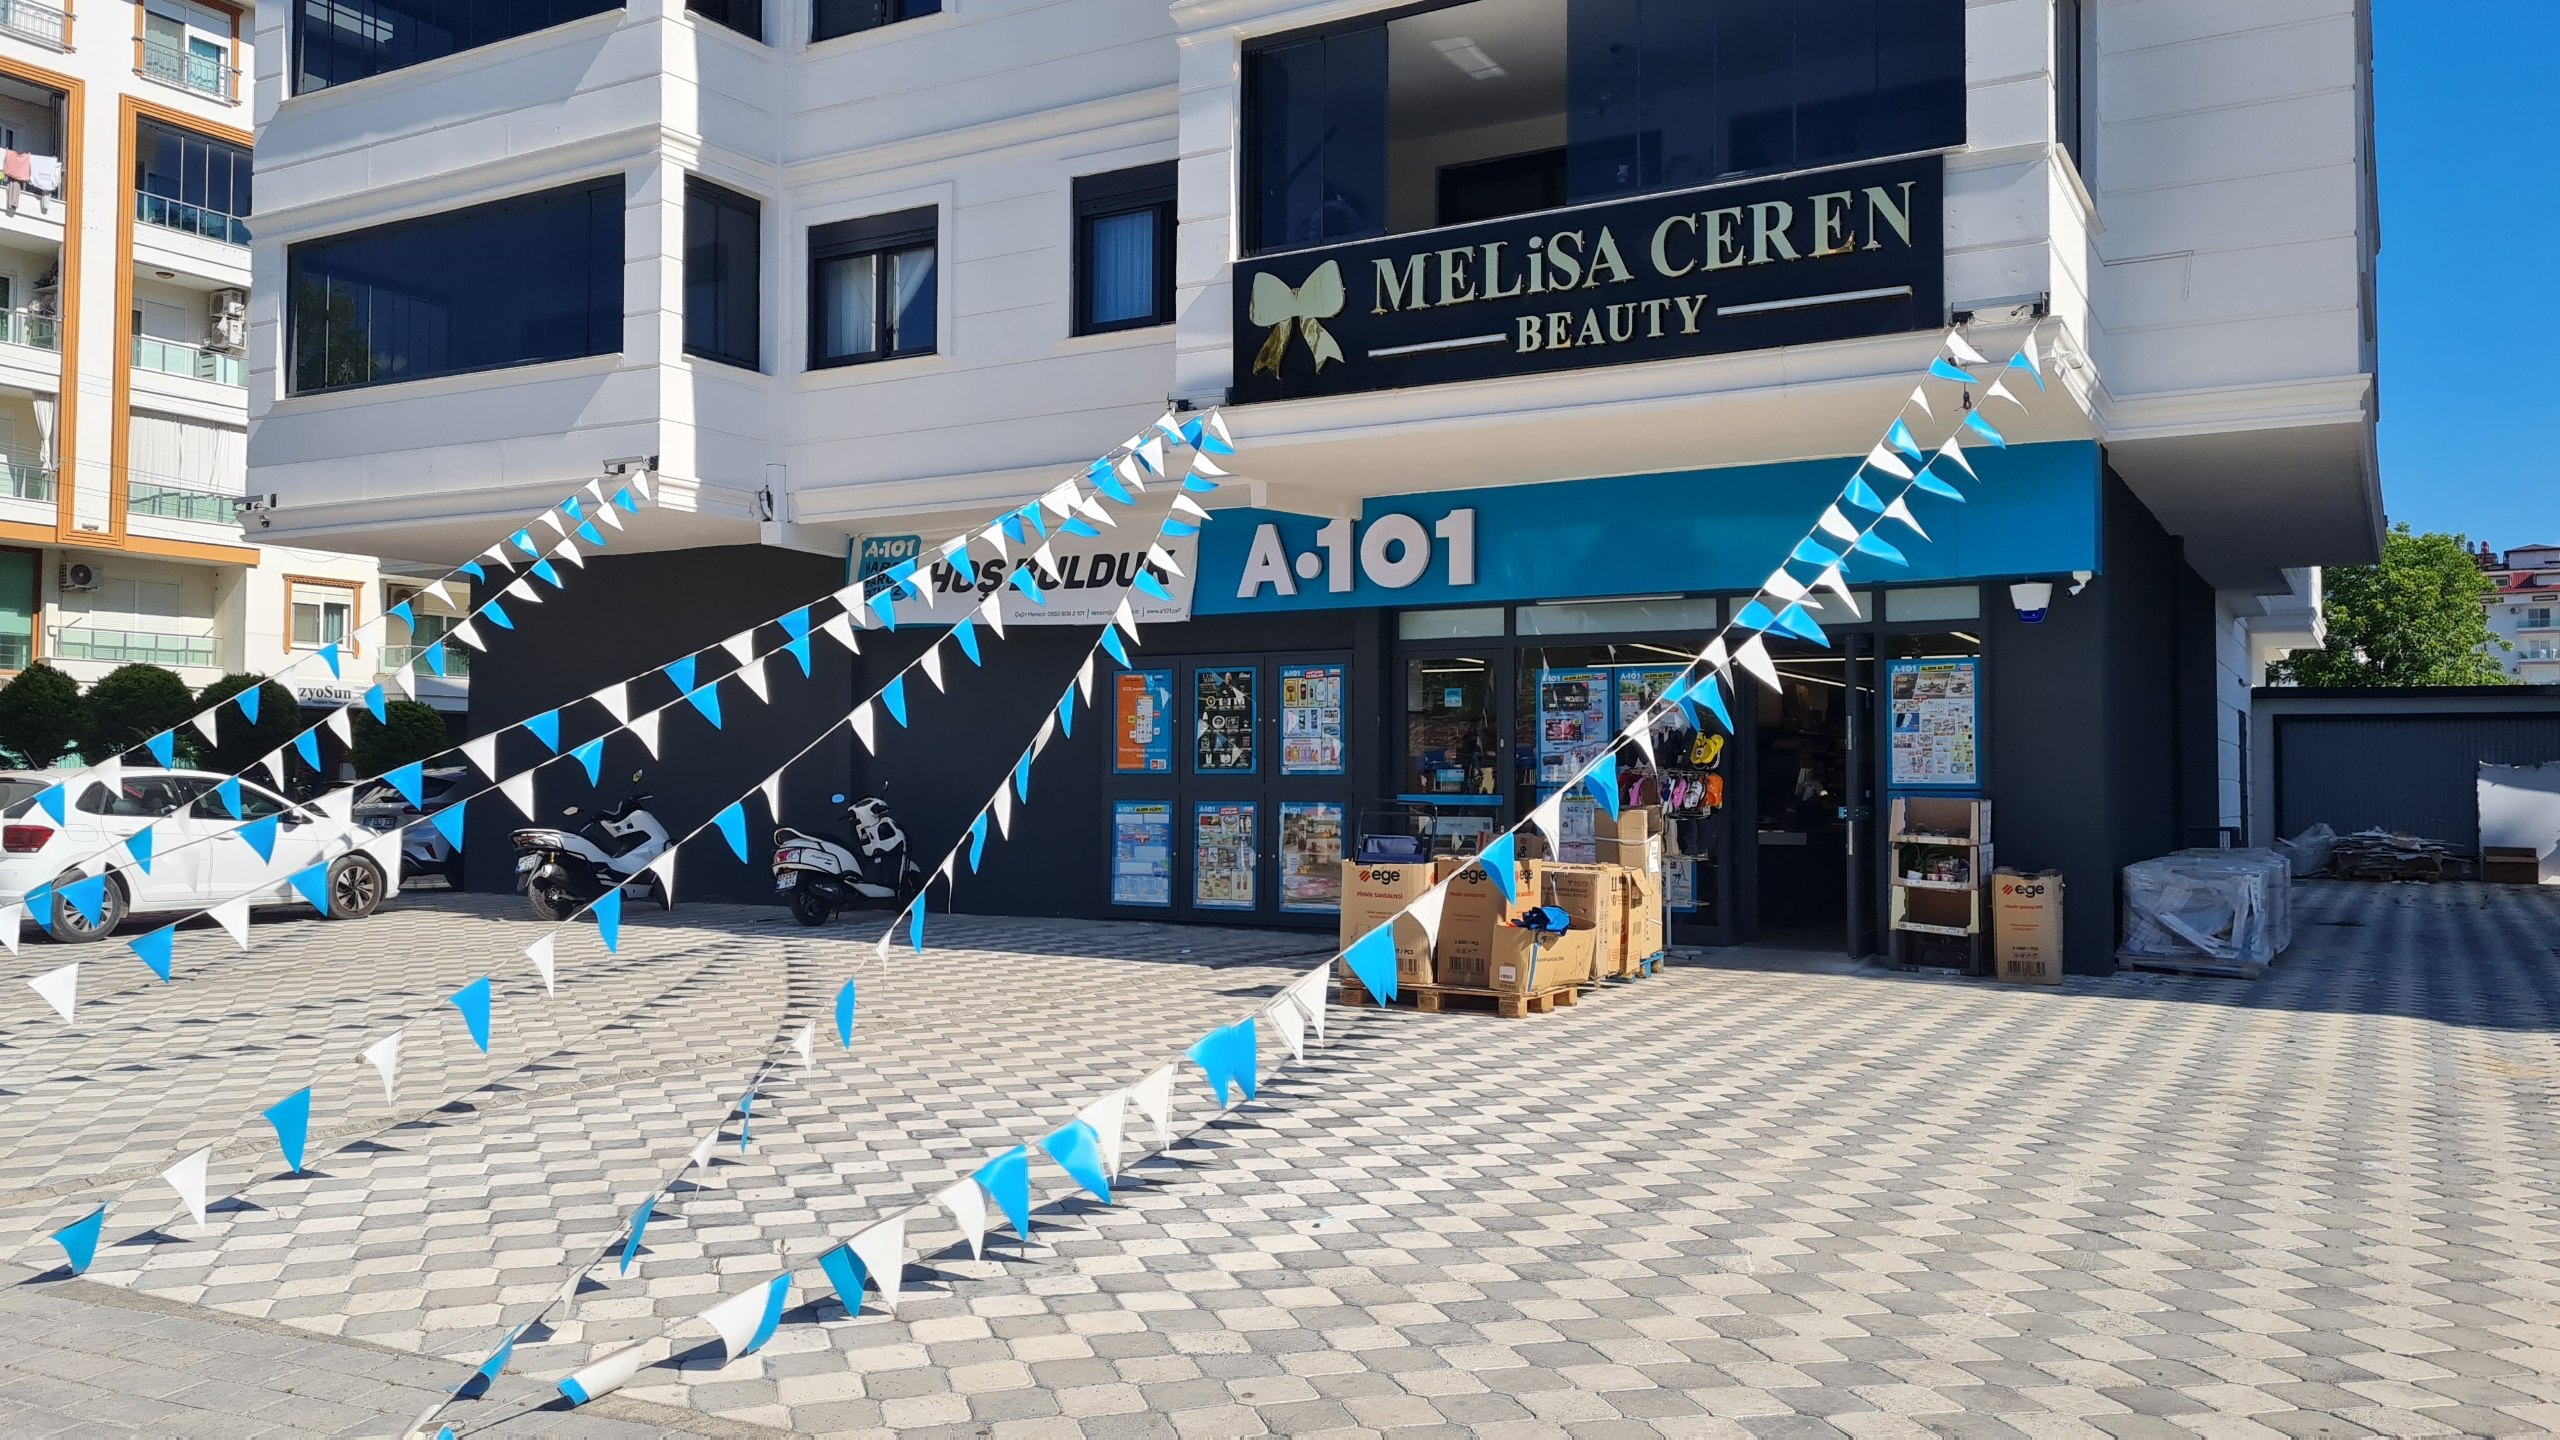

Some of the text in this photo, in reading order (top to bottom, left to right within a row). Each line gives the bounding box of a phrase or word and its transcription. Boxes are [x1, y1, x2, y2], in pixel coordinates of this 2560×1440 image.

[1651, 182, 1917, 279] CEREN
[1515, 294, 1708, 354] BEAUTY
[930, 558, 1006, 602] HOŞ
[1371, 870, 1401, 885] ege
[1460, 869, 1488, 884] ege
[2015, 884, 2045, 898] ege
